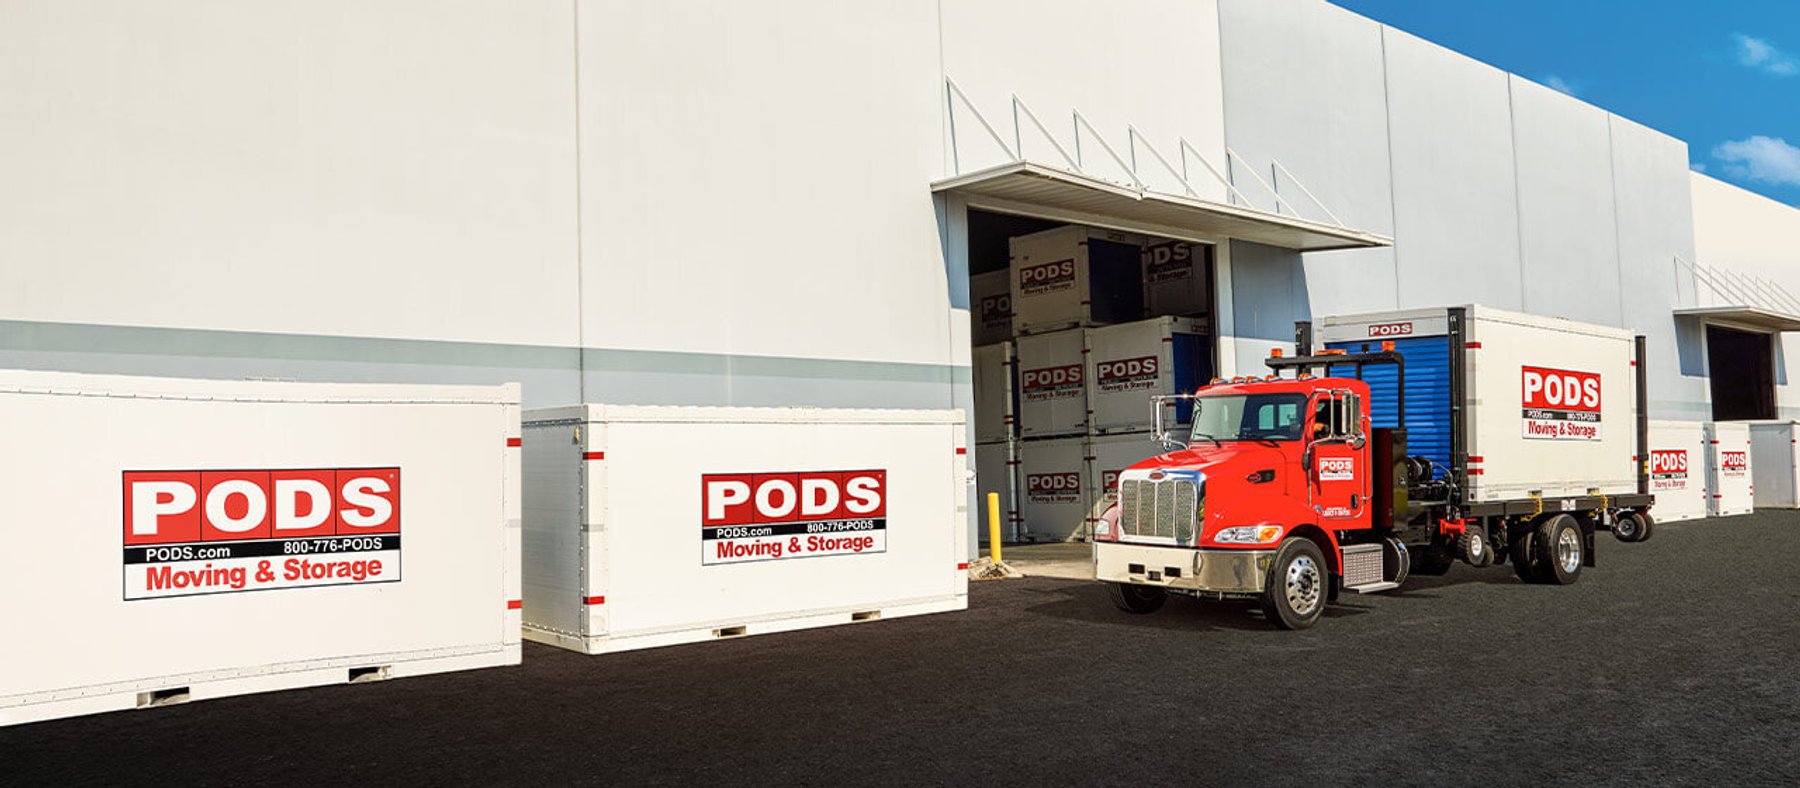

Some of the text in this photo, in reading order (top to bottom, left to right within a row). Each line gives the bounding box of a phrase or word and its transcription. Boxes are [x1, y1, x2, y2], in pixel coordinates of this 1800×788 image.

[1148, 243, 1189, 265] DS
[1022, 261, 1073, 283] PODS
[983, 297, 1010, 314] PO
[1369, 324, 1411, 335] PODS
[1024, 367, 1081, 387] PODS
[1099, 359, 1156, 378] PODS
[1523, 371, 1599, 408] PODS
[1528, 421, 1596, 438] Moving & Storage
[1321, 461, 1352, 471] PODS
[1652, 453, 1686, 471] PODS
[1722, 454, 1745, 466] PODS
[1028, 475, 1078, 489] PODS
[132, 477, 392, 535] PODS
[707, 476, 881, 520] PODS
[716, 520, 874, 539] PODS.com 800-776-PODS
[146, 537, 382, 562] PODS.com 800-776-PODS
[717, 535, 873, 559] Moving & Storage
[146, 556, 382, 590] Moving & Storage
